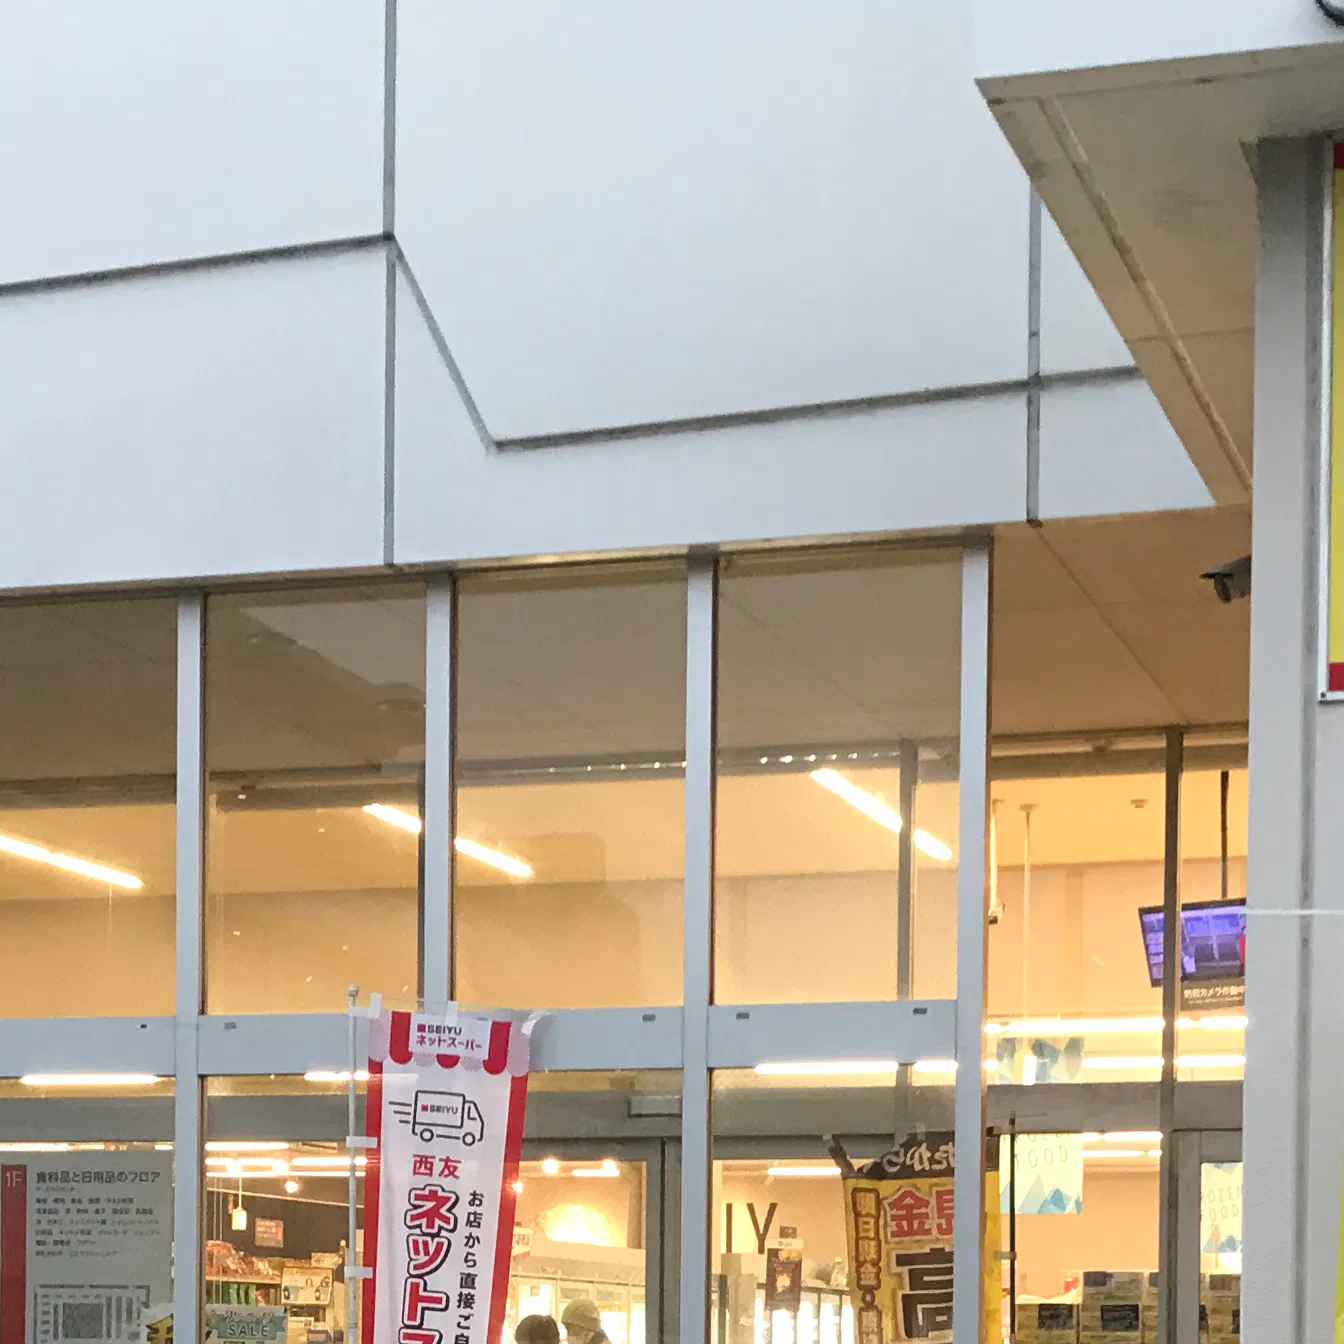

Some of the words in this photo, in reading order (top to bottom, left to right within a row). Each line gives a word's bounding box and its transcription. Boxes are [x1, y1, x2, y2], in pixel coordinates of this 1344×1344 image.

[427, 1024, 462, 1036] SEIYU
[416, 1034, 483, 1051] ネットスーパー
[429, 1104, 459, 1115] SEIYU
[412, 1153, 463, 1181] 西友
[227, 1324, 269, 1337] SALE
